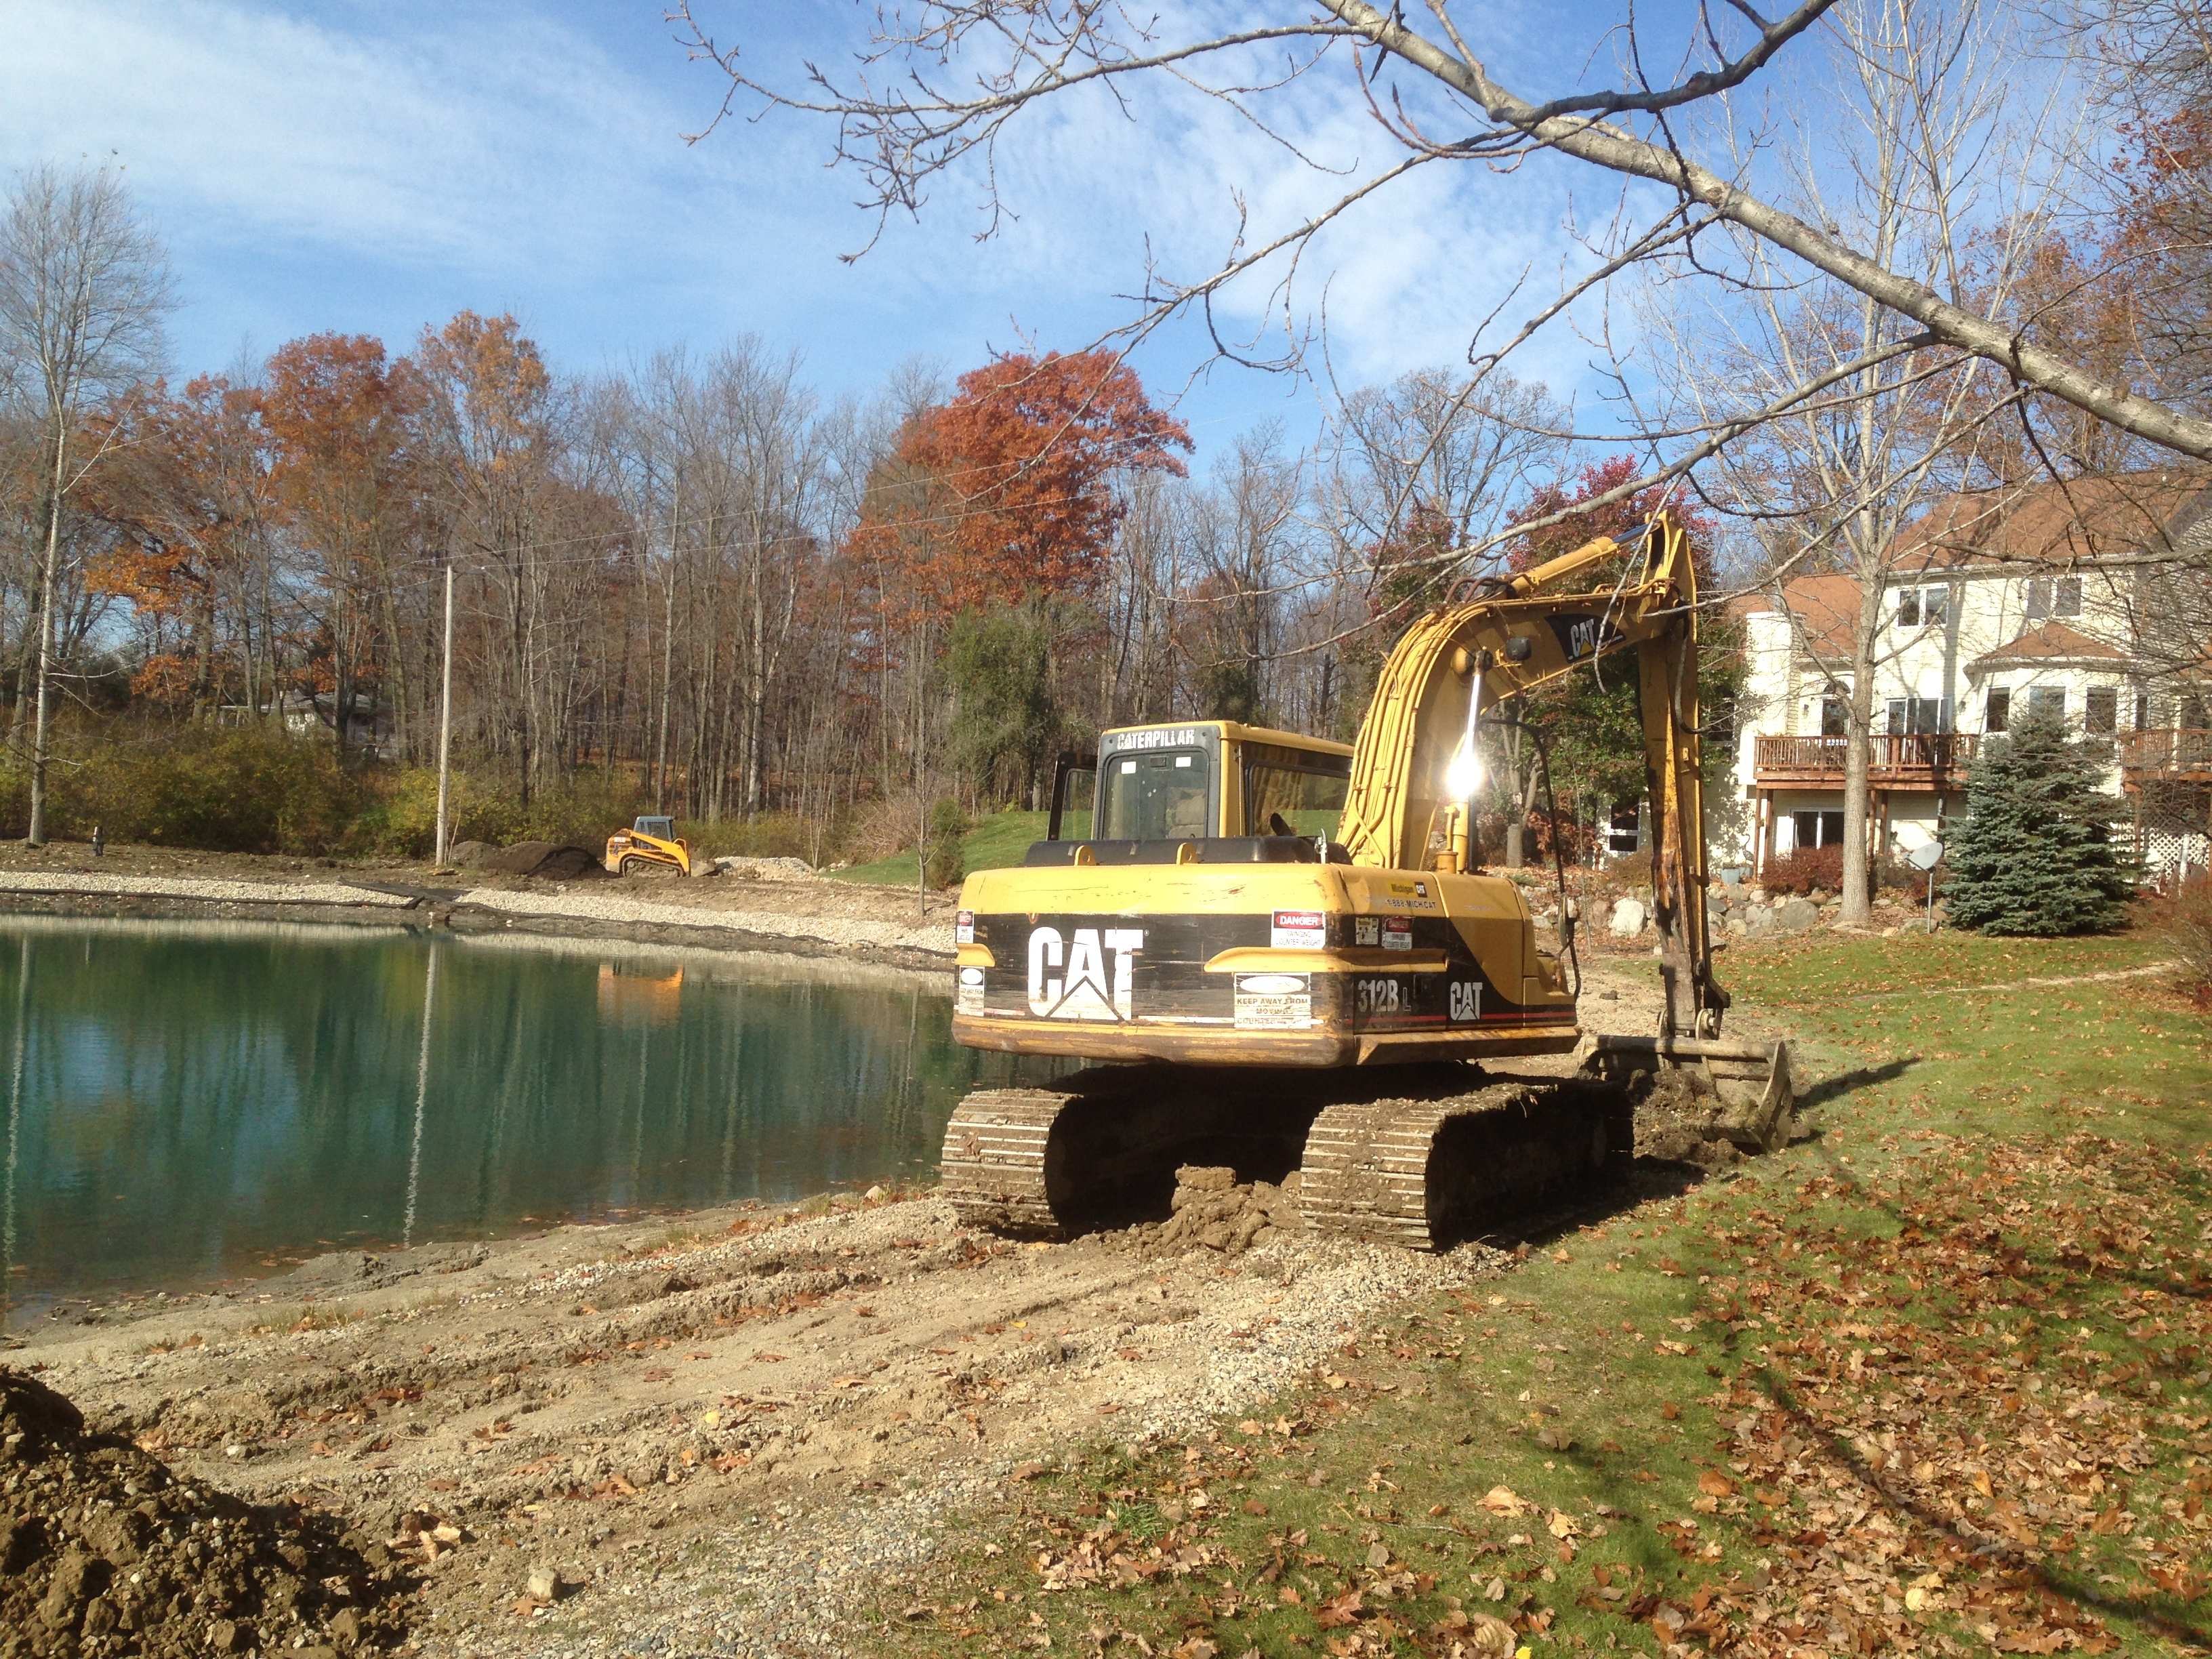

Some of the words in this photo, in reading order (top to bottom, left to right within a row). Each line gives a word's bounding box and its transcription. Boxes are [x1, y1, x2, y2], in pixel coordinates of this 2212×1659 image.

[1570, 618, 1595, 657] CAT
[1117, 729, 1195, 750] CATERPILLAR
[1279, 916, 1318, 926] DANGER
[1028, 926, 1143, 1021] CAT
[1357, 979, 1399, 1012] 312B
[1402, 987, 1412, 1011] L
[1450, 981, 1483, 1021] CAT
